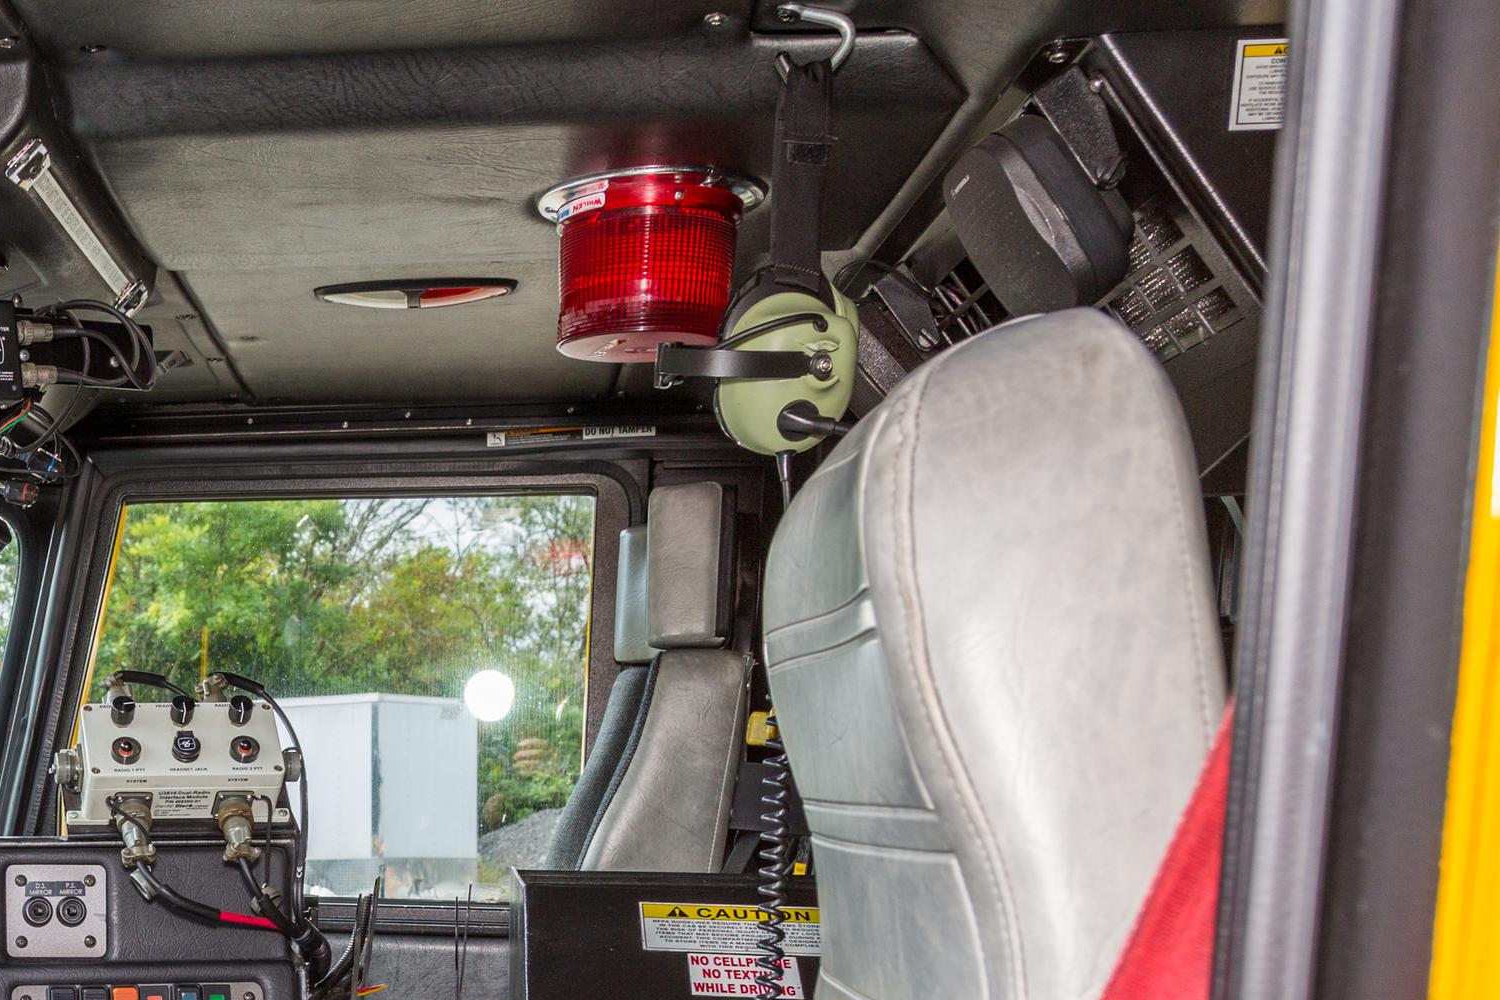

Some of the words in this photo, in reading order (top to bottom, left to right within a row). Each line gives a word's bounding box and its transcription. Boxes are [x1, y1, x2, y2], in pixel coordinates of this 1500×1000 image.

[585, 427, 597, 436] DO
[600, 426, 614, 435] NOT
[618, 426, 653, 434] TAMPER
[690, 956, 709, 966] NO
[713, 956, 792, 969] CELLPNE
[702, 969, 721, 979] NO
[694, 982, 736, 994] WHILE
[740, 984, 796, 996] DRIVNG
